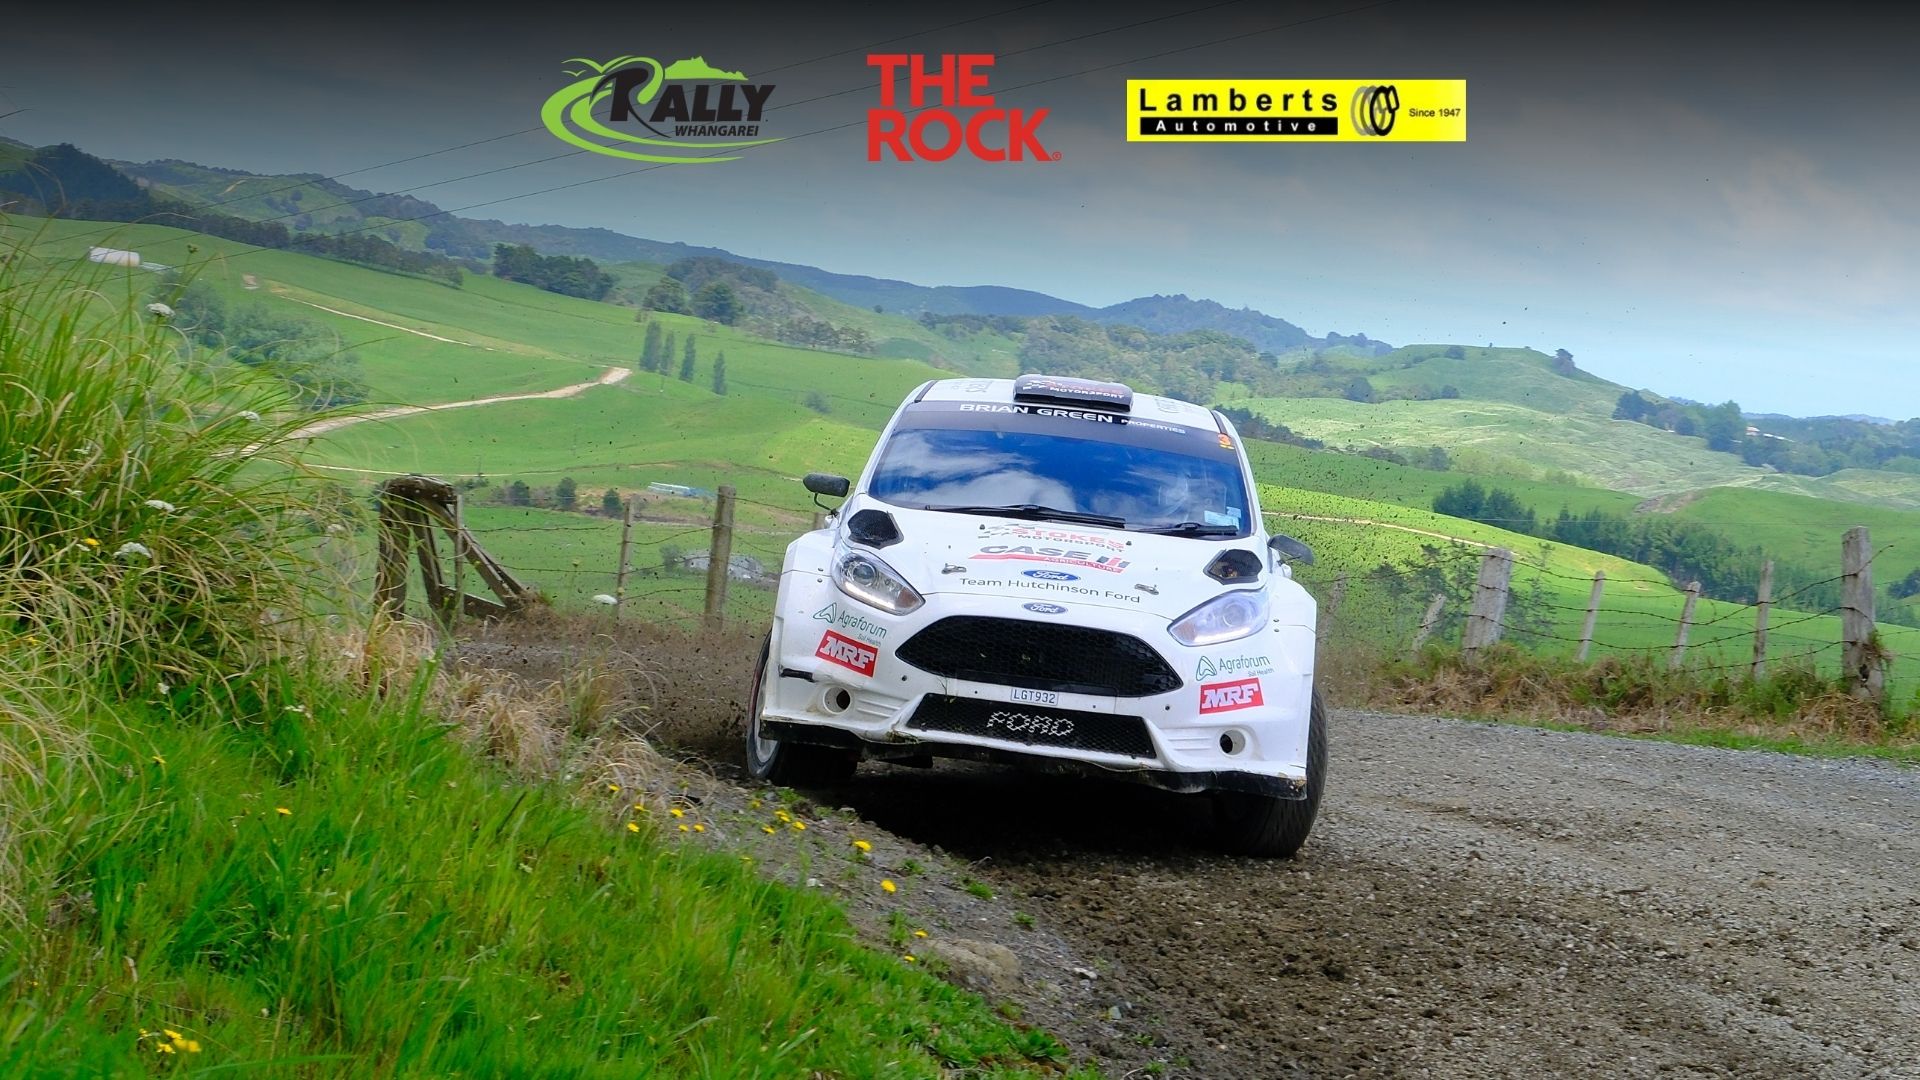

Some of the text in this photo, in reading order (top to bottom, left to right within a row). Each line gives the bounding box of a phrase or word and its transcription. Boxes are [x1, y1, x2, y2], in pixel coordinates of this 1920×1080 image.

[1049, 386, 1125, 399] MOTORSPORT
[959, 403, 1186, 435] BRIAN GREEN PROPERTIES
[1011, 527, 1125, 550] STOKES
[1018, 534, 1125, 553] MOTORSPORT
[979, 545, 1092, 560] CASE
[1031, 569, 1070, 582] Ford
[959, 577, 1141, 604] Team Hutchinson Ford
[1030, 602, 1060, 615] Ford
[837, 610, 888, 639] Agraforum
[819, 635, 876, 669] MRF
[1219, 654, 1271, 674] Agraforum
[1013, 688, 1056, 704] LGT932
[1201, 682, 1260, 709] MRF
[986, 711, 1075, 737] FORD
